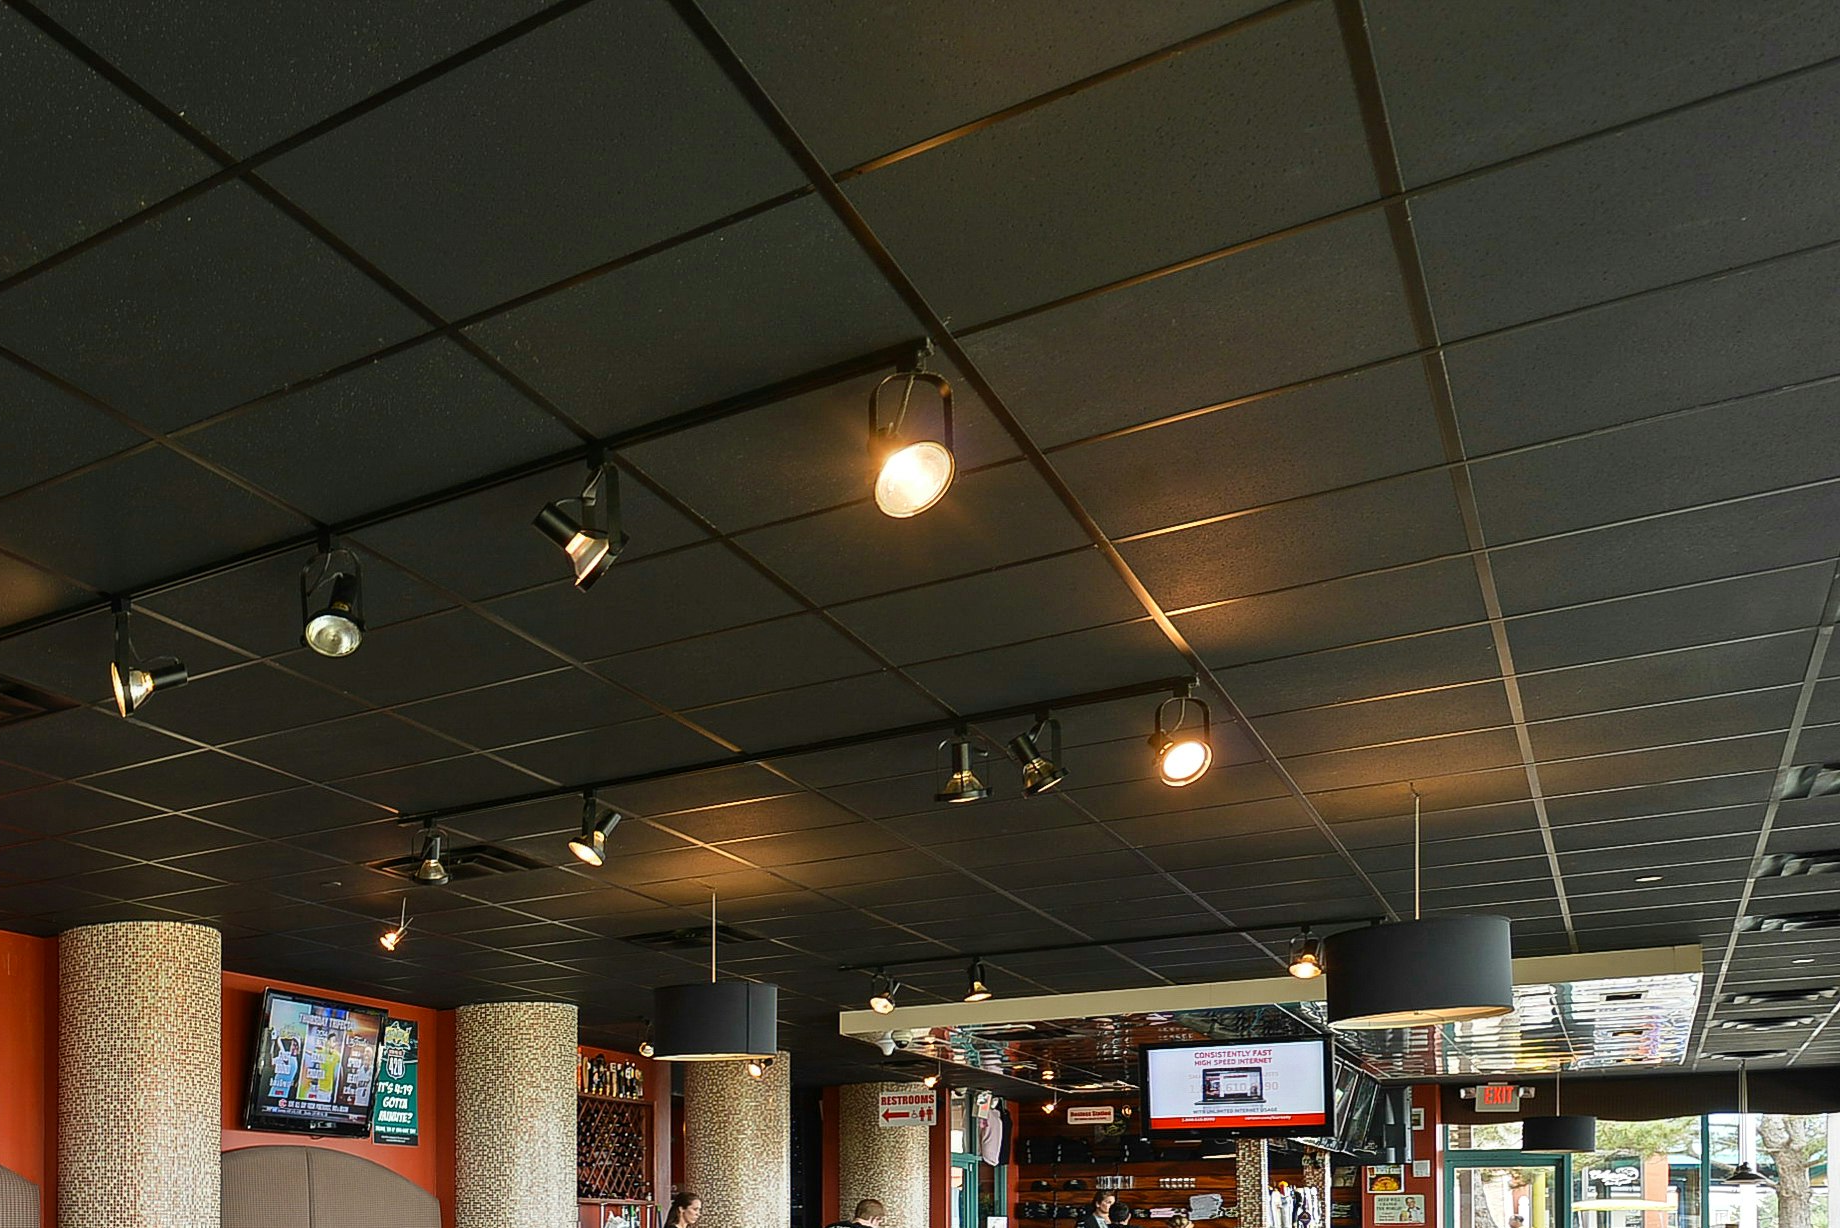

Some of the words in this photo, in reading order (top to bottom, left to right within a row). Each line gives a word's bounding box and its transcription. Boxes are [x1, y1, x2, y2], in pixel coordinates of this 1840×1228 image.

[1194, 1050, 1251, 1059] CONSISTENTLY
[1252, 1049, 1272, 1057] FAST
[388, 1057, 403, 1076] 420
[1237, 1057, 1272, 1065] INTERNET
[377, 1081, 394, 1094] IT'S
[394, 1084, 414, 1095] 4:19
[881, 1094, 935, 1106] RESTROOMS
[1484, 1086, 1514, 1105] EXIT
[382, 1097, 408, 1109] GOTTA
[378, 1111, 413, 1124] MINUTE?
